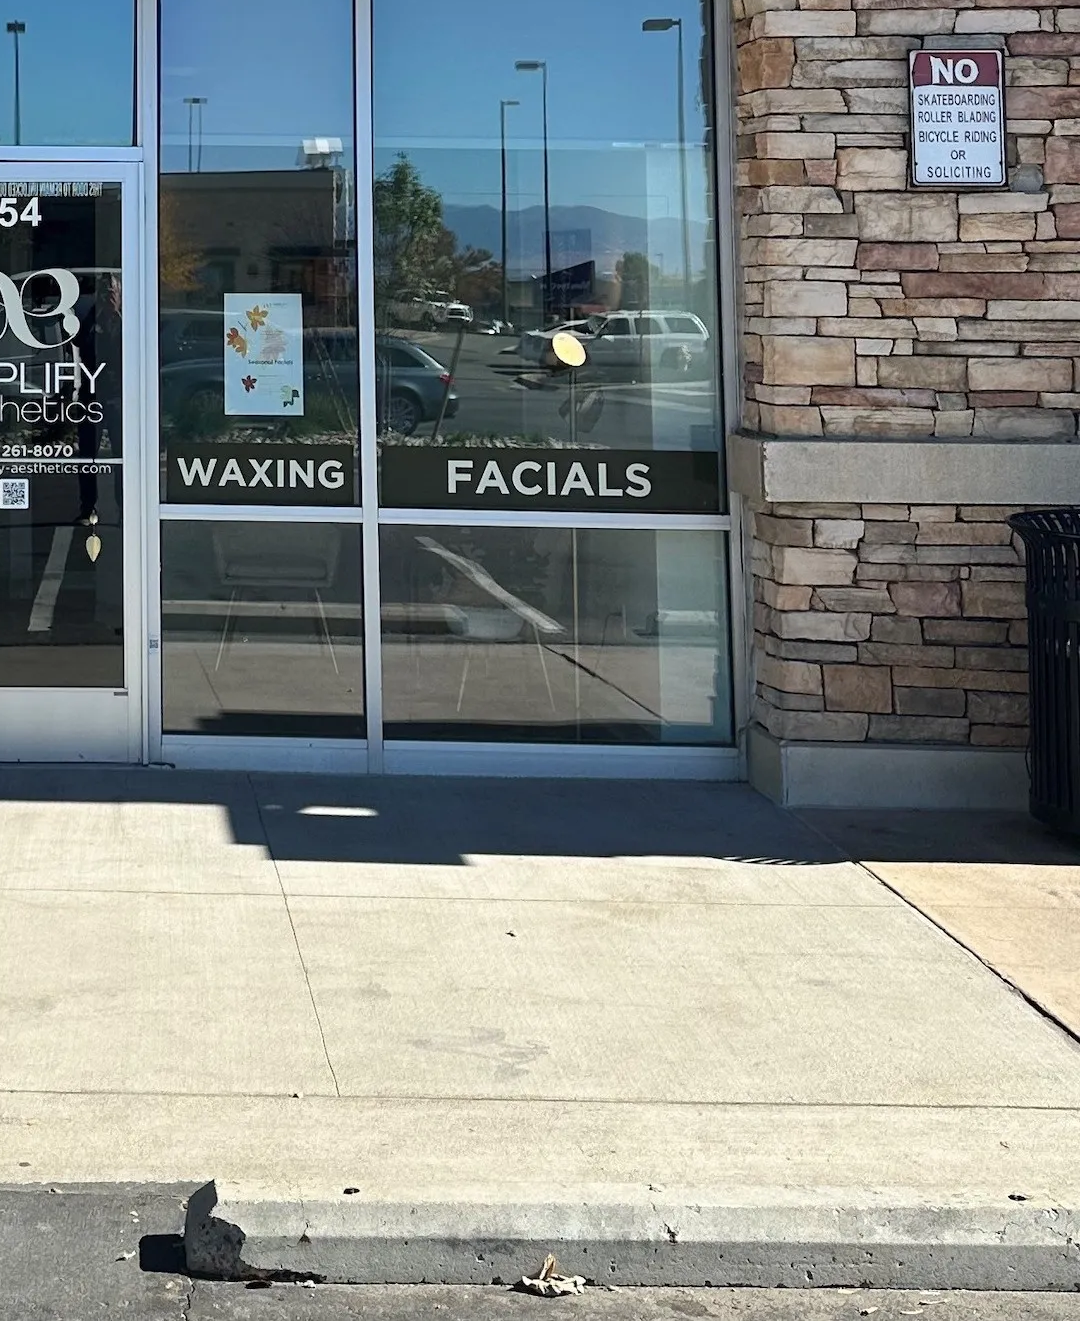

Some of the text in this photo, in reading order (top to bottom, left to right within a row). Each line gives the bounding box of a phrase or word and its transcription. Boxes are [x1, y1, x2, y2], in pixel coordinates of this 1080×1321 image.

[929, 55, 980, 85] NO
[918, 93, 996, 106] SKATEBOARDING
[917, 111, 996, 123] ROLLER BLADING
[918, 130, 997, 143] BICYCLE RIDING
[950, 149, 967, 160] OR
[927, 166, 992, 179] SOLICITING
[2, 444, 74, 458] 261-8070
[177, 457, 346, 489] WAXING
[446, 459, 653, 498] FACIALS
